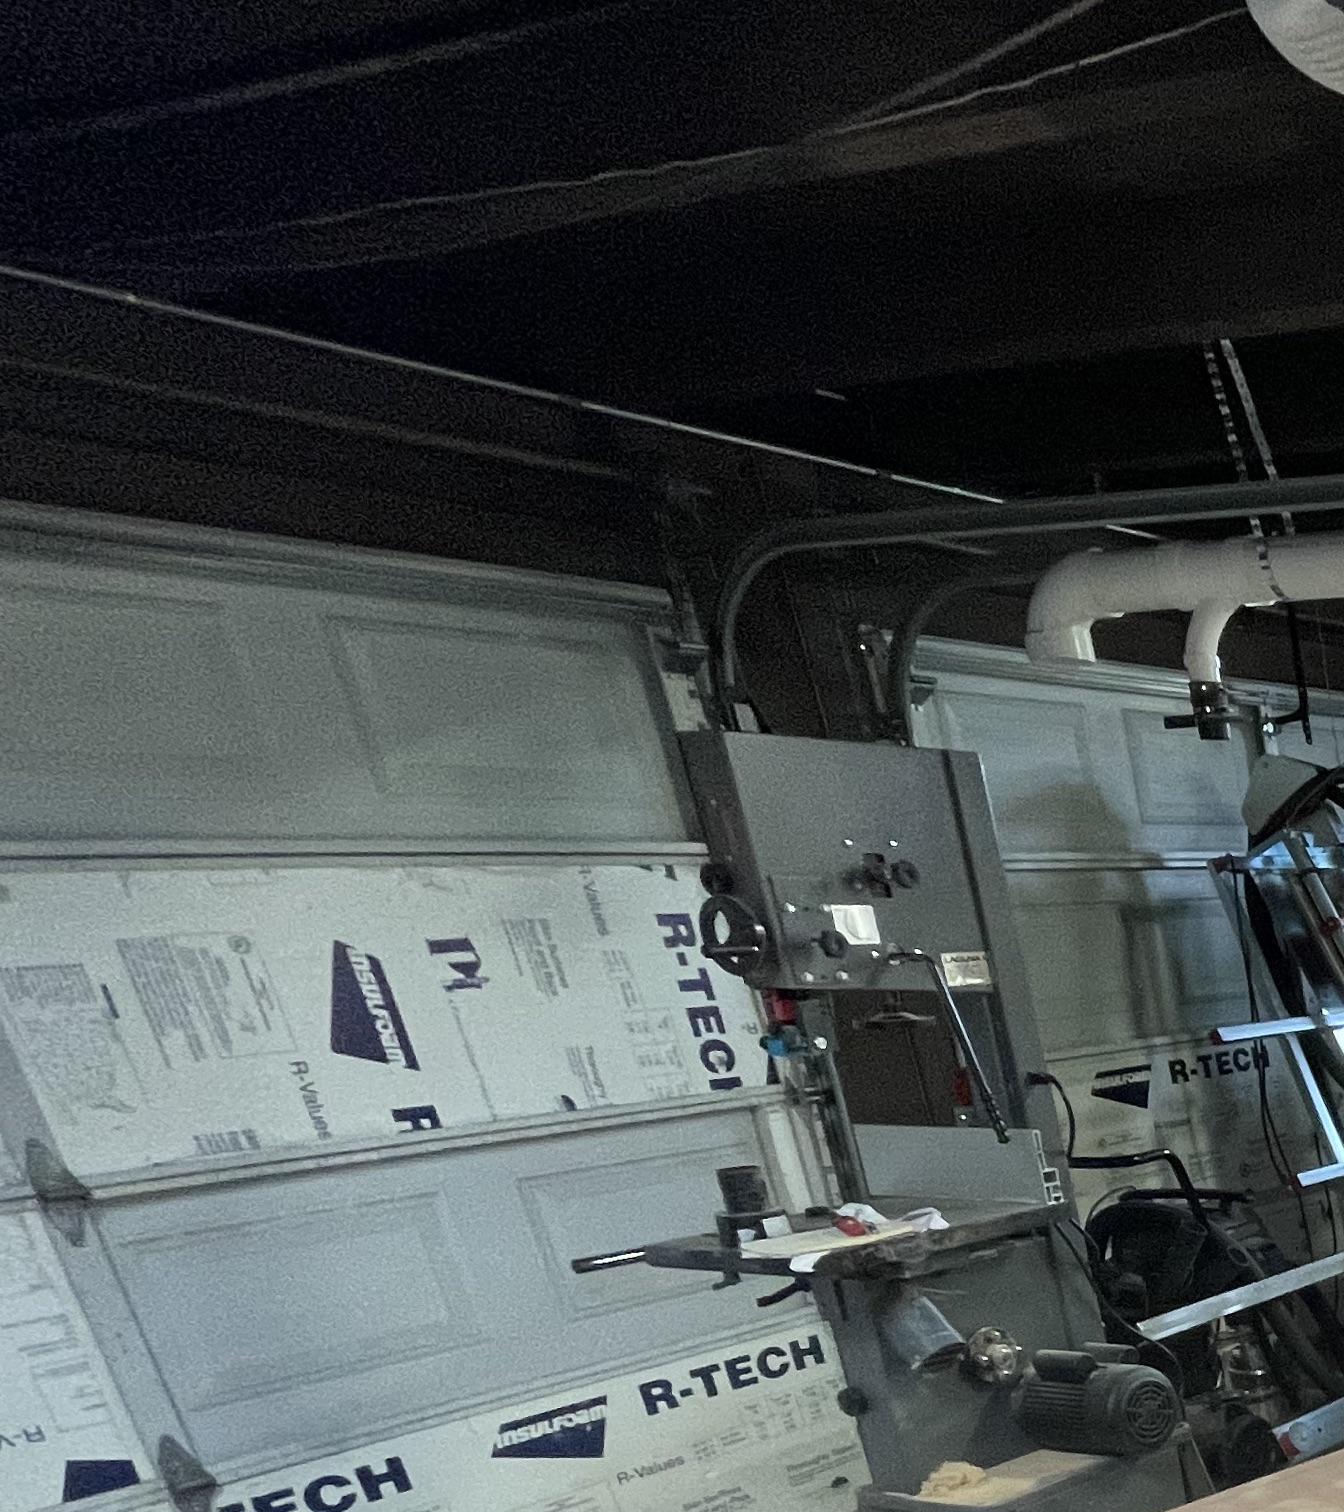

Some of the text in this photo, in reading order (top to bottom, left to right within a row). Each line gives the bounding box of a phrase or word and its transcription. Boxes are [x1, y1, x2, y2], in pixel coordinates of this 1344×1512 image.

[1167, 1046, 1270, 1085] R-TECH
[288, 1060, 333, 1141] R-Values
[638, 1334, 827, 1416] R-TECH
[615, 1455, 686, 1486] R-Values
